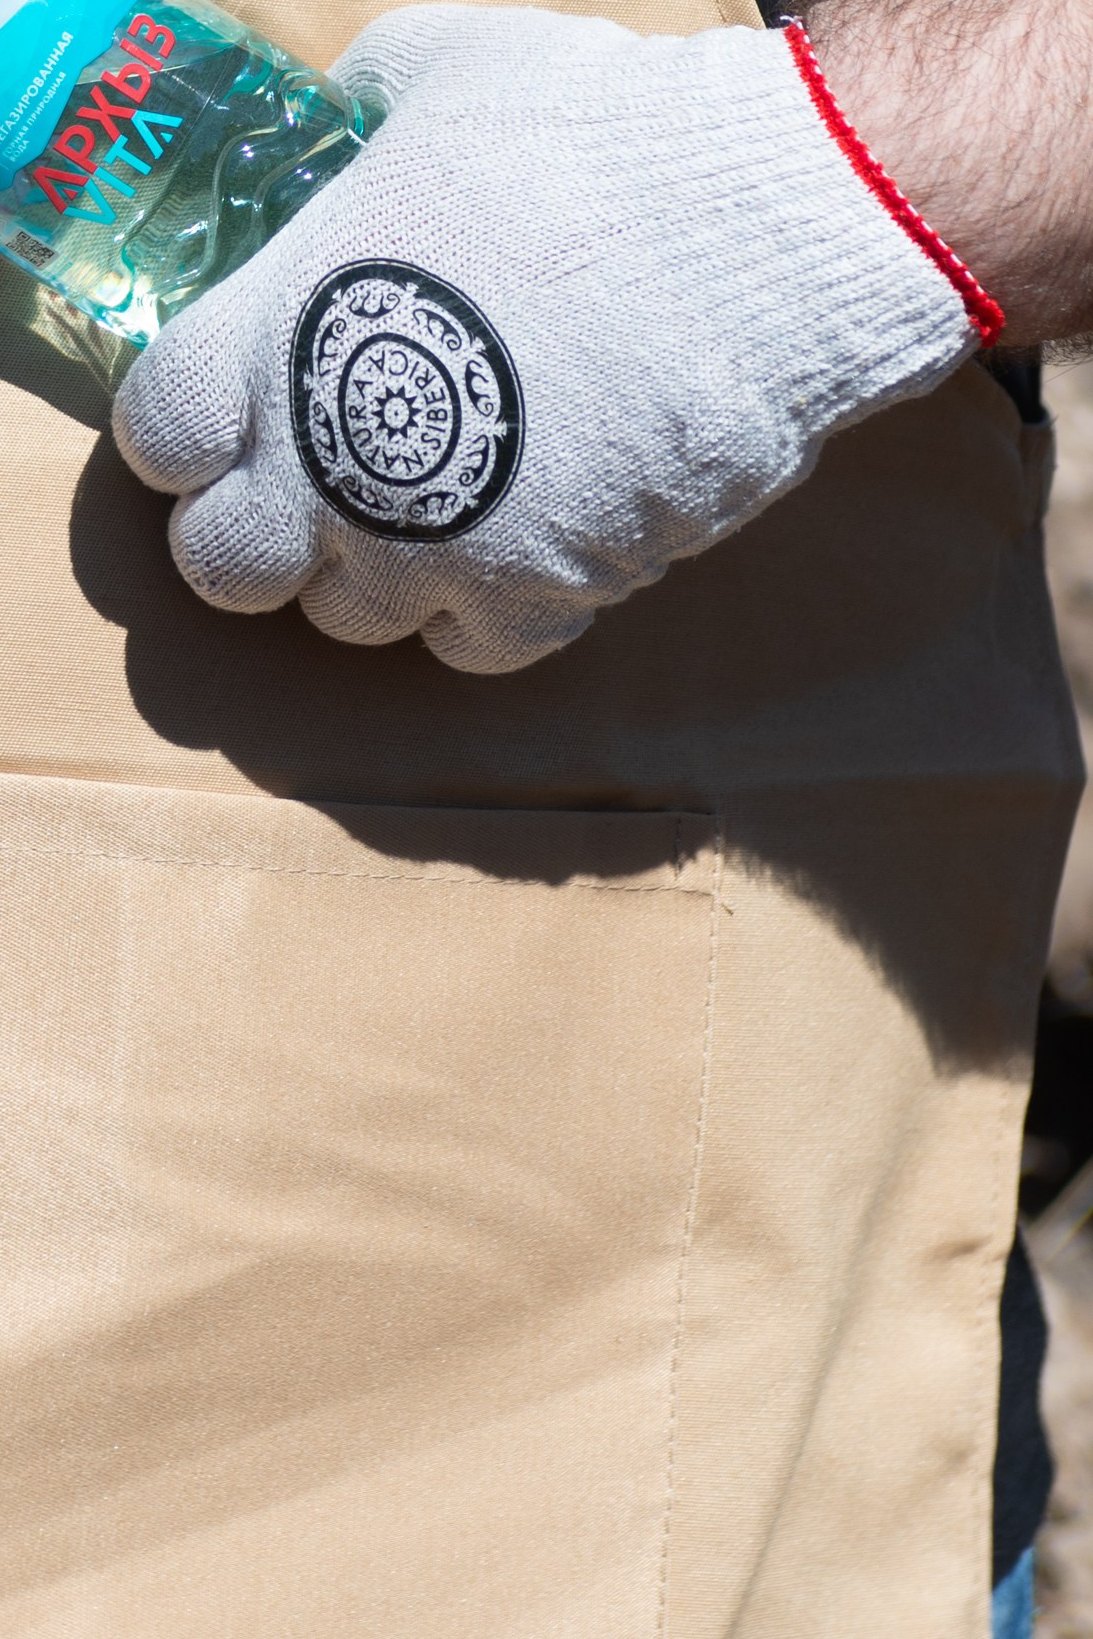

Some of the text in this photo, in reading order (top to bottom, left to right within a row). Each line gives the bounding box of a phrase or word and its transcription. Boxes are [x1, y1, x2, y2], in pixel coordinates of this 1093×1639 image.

[3, 71, 67, 158] ГОРНАЯ ПРИРОДНАЯ
[9, 139, 30, 162] ВОДА
[32, 14, 177, 215] АРХЫЗ
[63, 109, 184, 226] VITA
[348, 379, 425, 473] NATURA
[368, 349, 448, 451] SIBERICA
